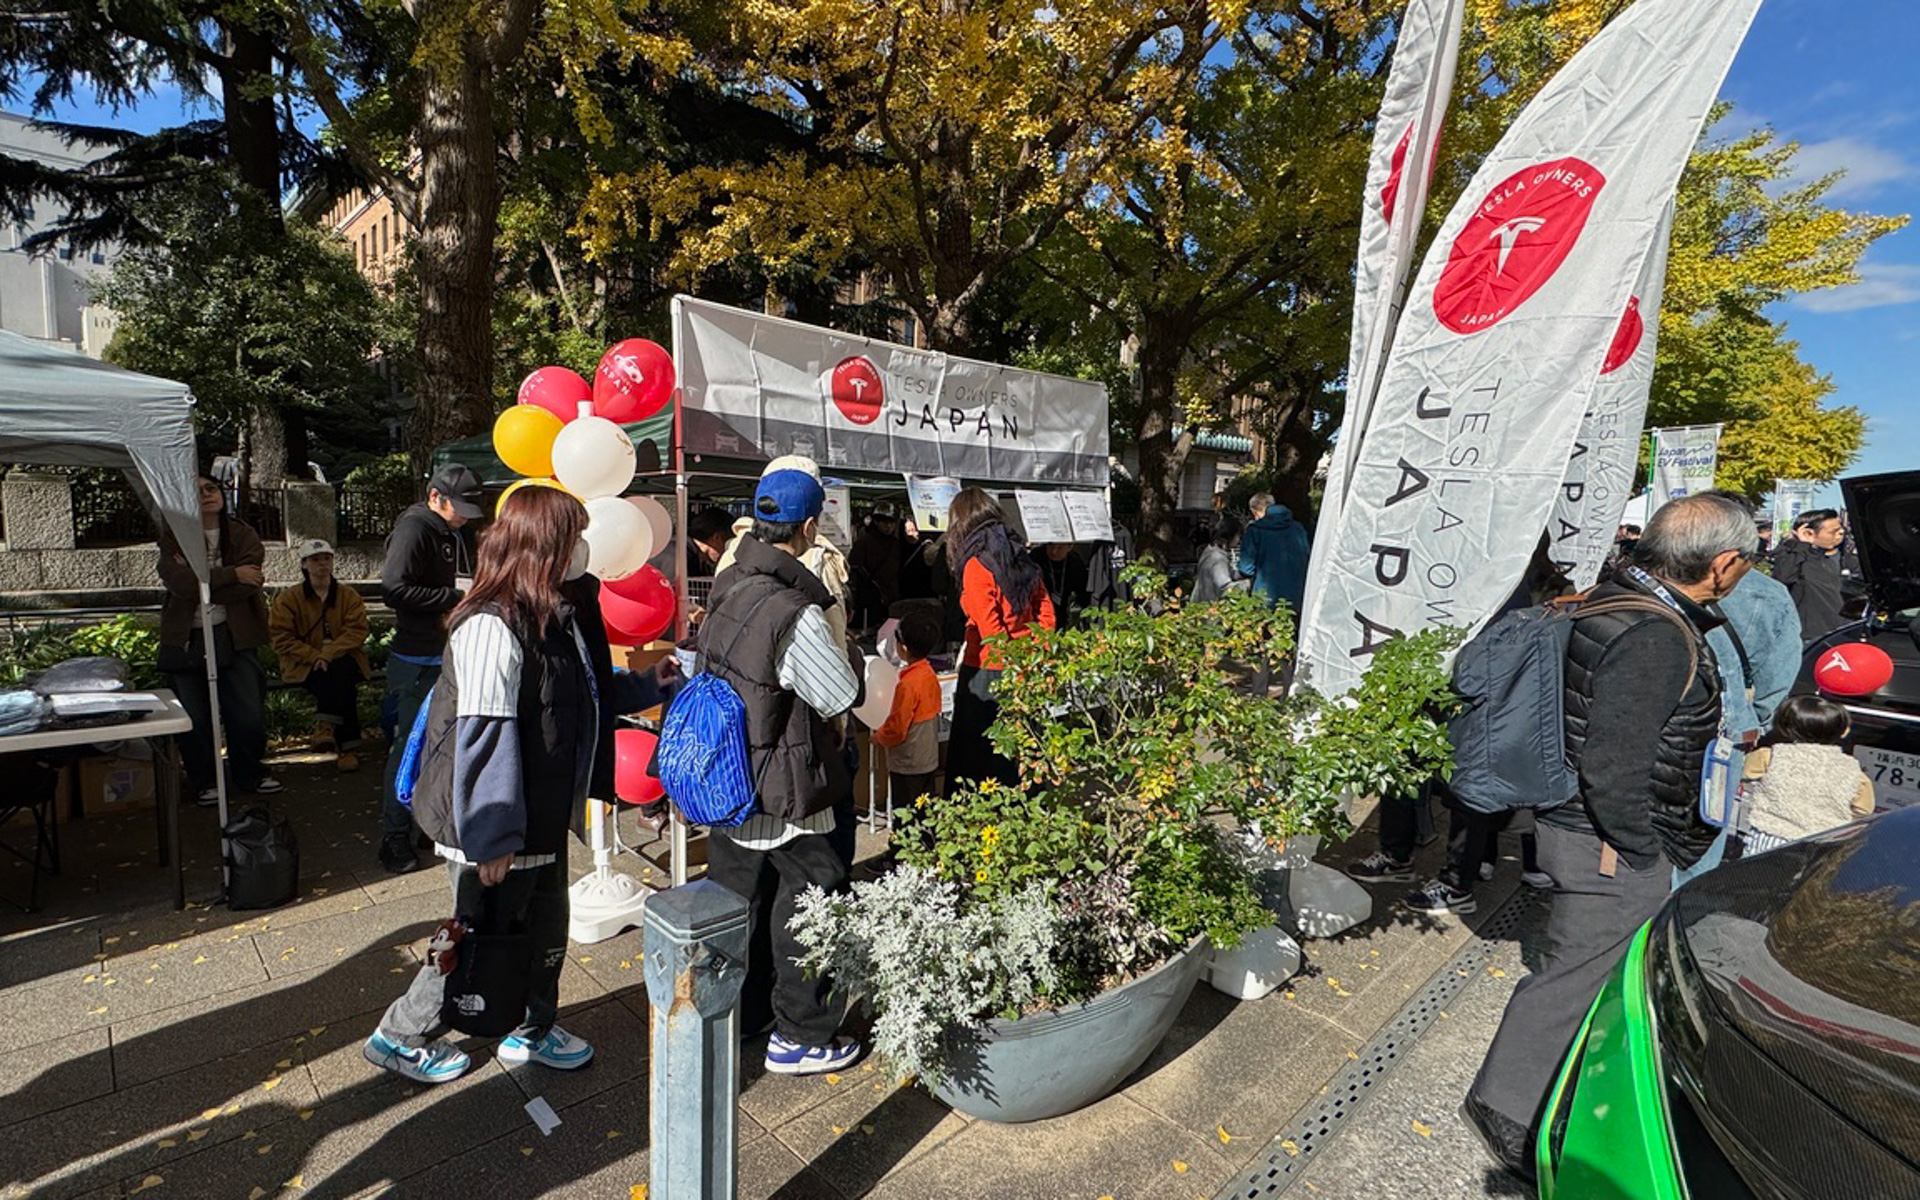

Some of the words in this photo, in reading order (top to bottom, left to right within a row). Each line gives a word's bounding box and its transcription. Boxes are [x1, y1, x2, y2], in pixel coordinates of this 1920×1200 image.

[1476, 181, 1525, 219] TESLA
[1460, 307, 1506, 324] JAPAN
[893, 374, 948, 398] TESLA
[955, 386, 1018, 408] OWNERS
[895, 400, 1019, 440] JAPAN
[1597, 397, 1621, 474] TESLA
[1432, 377, 1503, 533] TESLA
[1658, 458, 1673, 468] EV
[1672, 455, 1714, 468] Festival
[1683, 466, 1713, 478] 2025
[1349, 385, 1452, 658] JAPA
[1579, 485, 1611, 587] OWNERS
[1873, 763, 1920, 790] 78-
